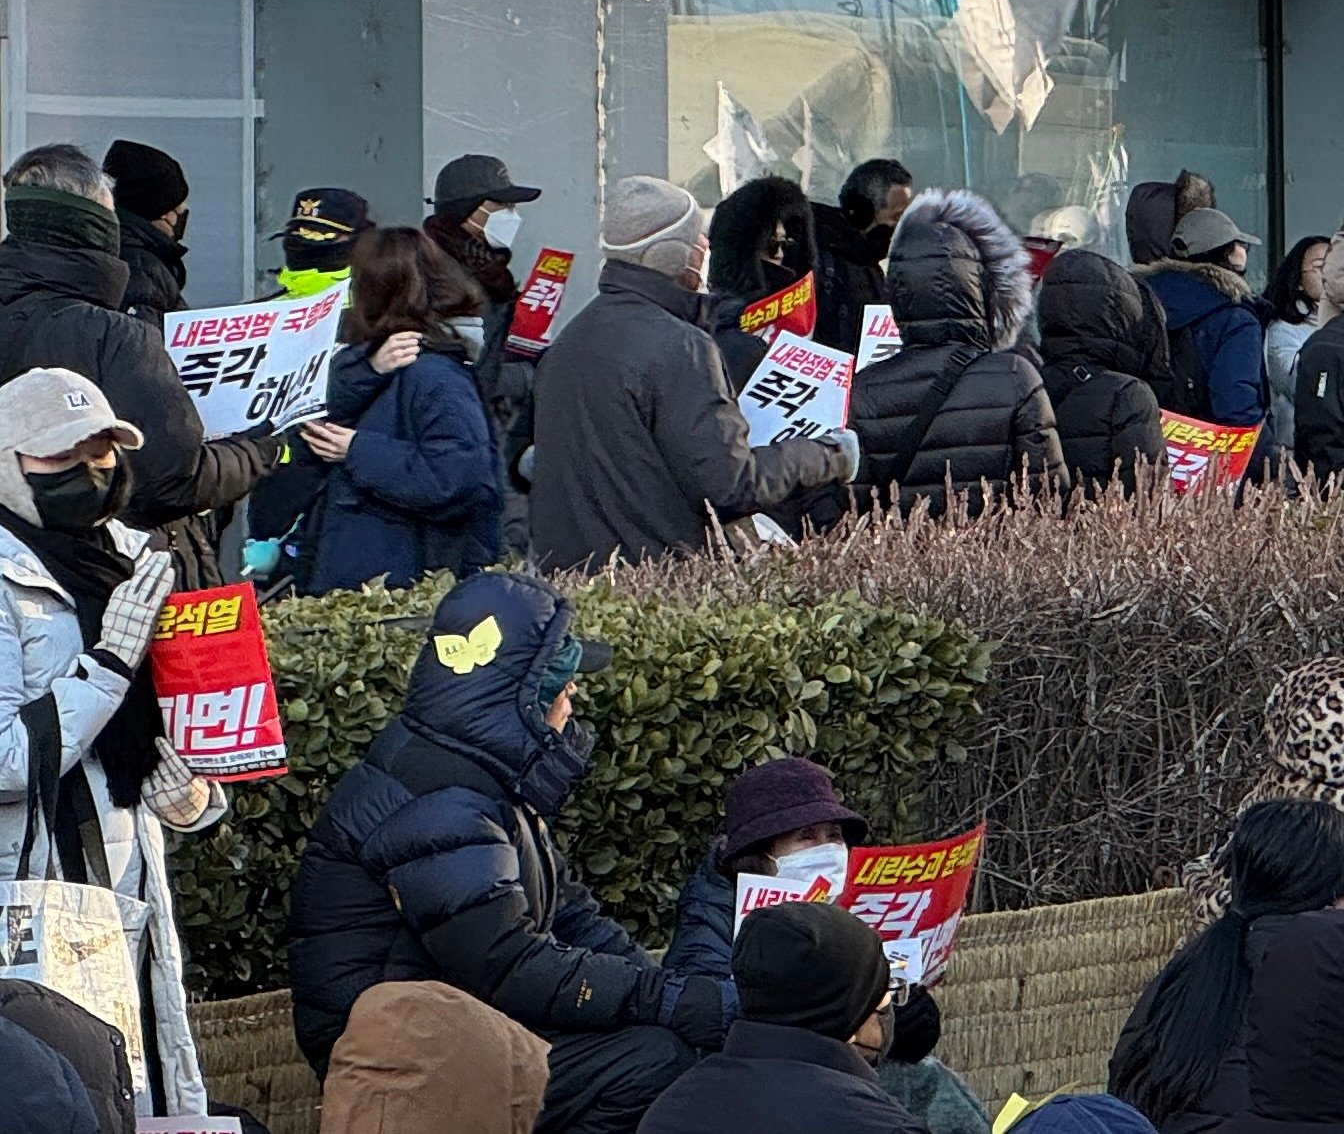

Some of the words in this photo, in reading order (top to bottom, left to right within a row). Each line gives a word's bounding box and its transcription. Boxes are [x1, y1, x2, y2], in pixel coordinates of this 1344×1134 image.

[170, 311, 280, 348] 내란정범
[281, 289, 342, 334] 국힘당
[519, 277, 565, 316] 즉각
[179, 343, 268, 398] 즉각
[246, 349, 329, 421] 해산!
[768, 342, 838, 383] 내란정범
[67, 392, 90, 408] LA
[746, 369, 820, 419] 즉각
[153, 594, 243, 640] 윤석열
[853, 850, 942, 887] 내란수괴
